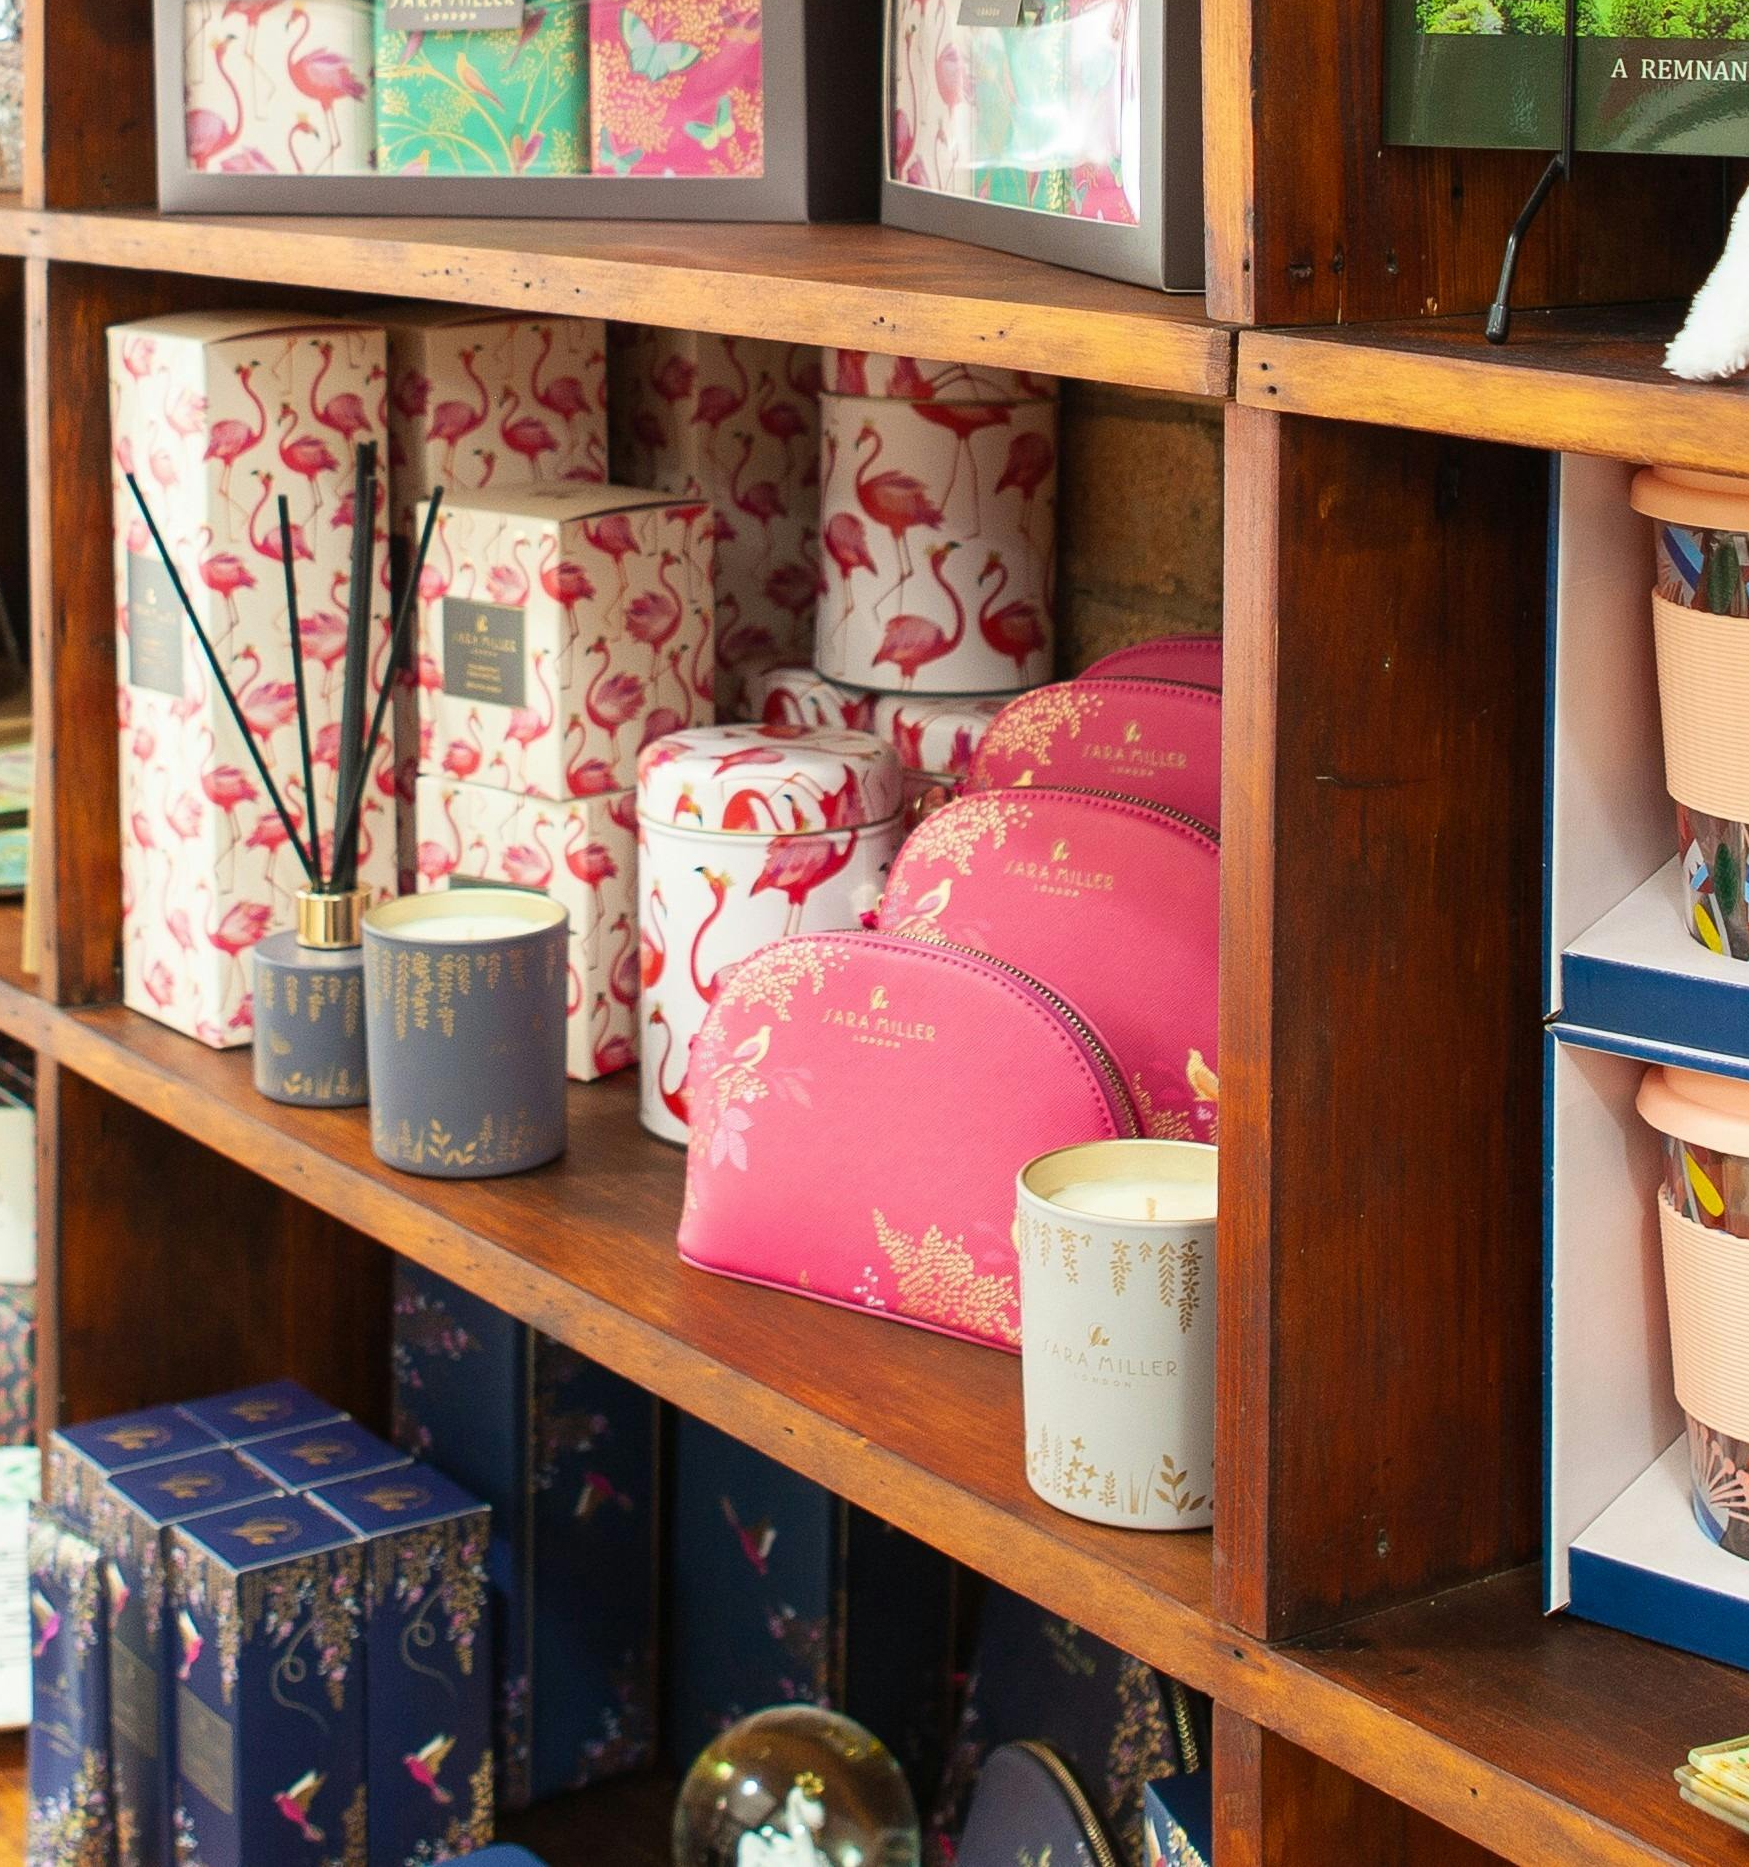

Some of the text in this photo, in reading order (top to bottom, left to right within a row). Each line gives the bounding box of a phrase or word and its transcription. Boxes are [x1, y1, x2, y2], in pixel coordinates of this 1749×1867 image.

[1610, 58, 1628, 79] A
[1003, 859, 1114, 891] SARA MILLER
[821, 1008, 937, 1042] SARA MILLER
[1042, 1338, 1180, 1377] SARA MILLER
[1073, 1372, 1132, 1389] LONDON
